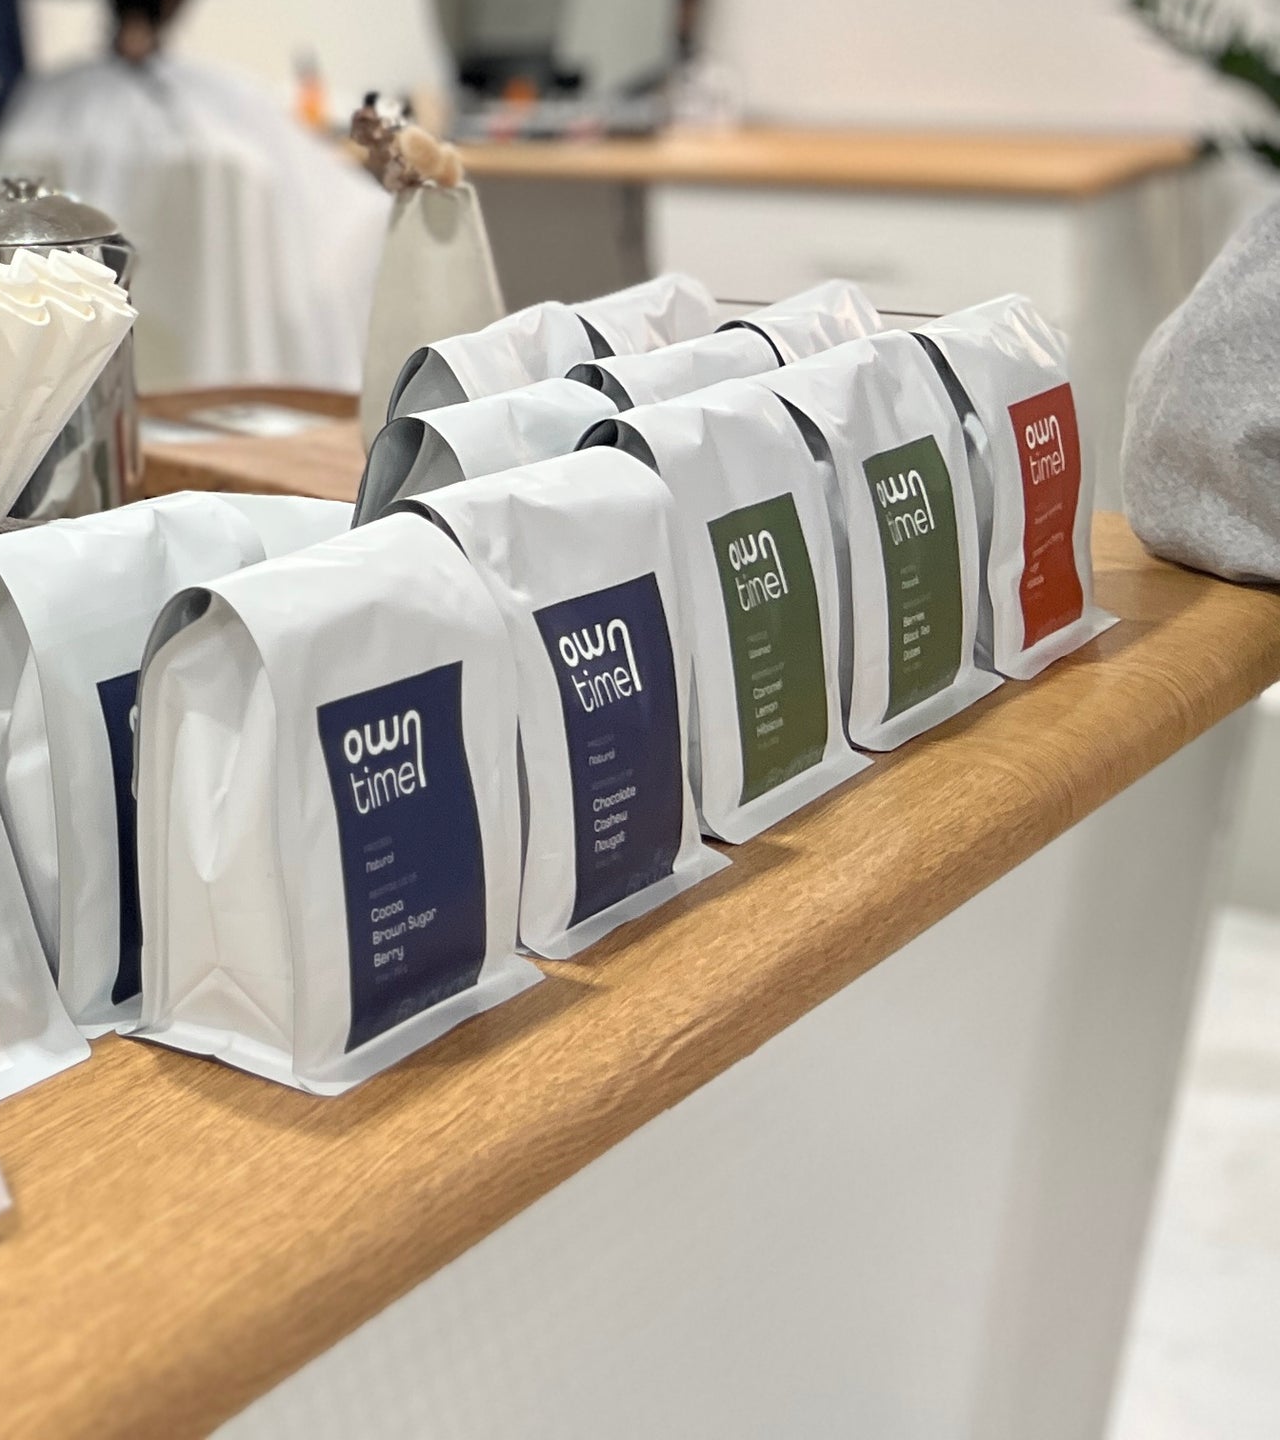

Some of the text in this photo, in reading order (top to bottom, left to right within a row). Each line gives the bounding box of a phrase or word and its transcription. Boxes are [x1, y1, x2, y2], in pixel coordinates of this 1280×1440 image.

[1024, 414, 1066, 472] own
[1028, 451, 1061, 486] time
[875, 469, 935, 530] own
[728, 529, 789, 594] own
[735, 572, 781, 612] time
[558, 618, 643, 692] own
[571, 666, 633, 713] time
[343, 709, 427, 788] own
[349, 762, 416, 814] time
[592, 785, 637, 812] Chocolate
[593, 810, 629, 833] Cashew
[370, 899, 405, 923] Cocoa
[372, 908, 438, 946] Brown Sugar
[373, 945, 405, 968] Berry
